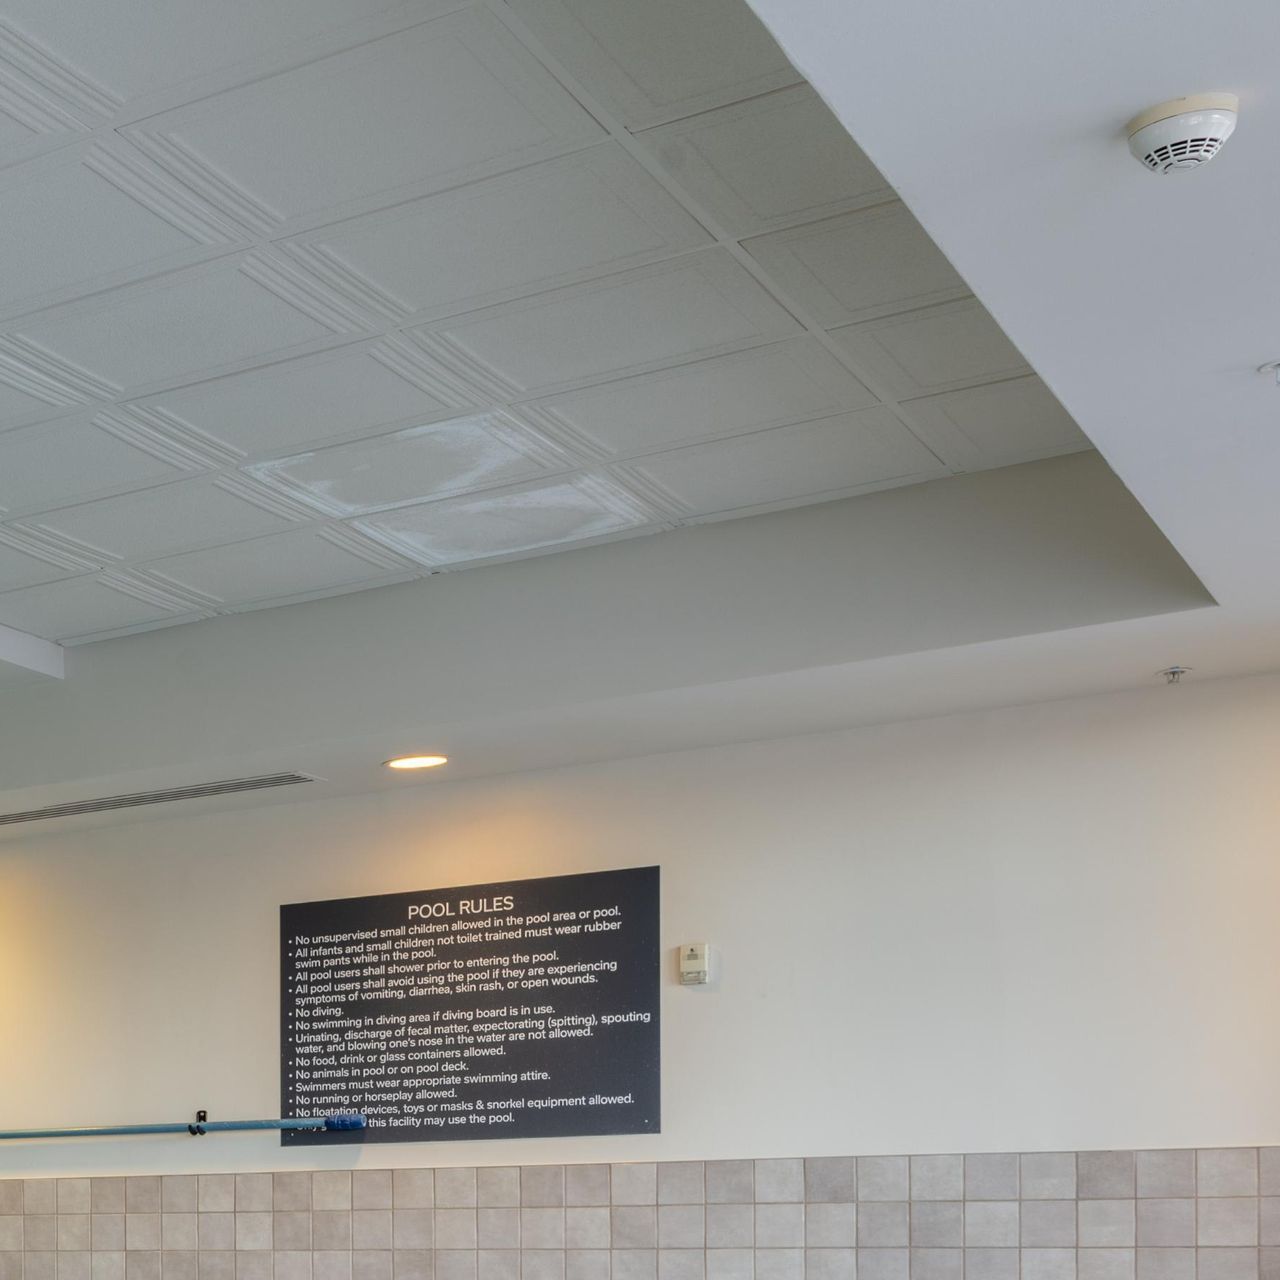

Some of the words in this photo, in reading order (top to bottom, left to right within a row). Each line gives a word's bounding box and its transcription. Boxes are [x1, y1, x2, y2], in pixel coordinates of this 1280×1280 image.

[408, 902, 455, 919] POOL
[459, 896, 513, 914] RULES
[295, 935, 309, 945] No
[312, 928, 377, 943] unsupervised
[380, 925, 405, 937] small
[408, 923, 448, 934] children
[451, 917, 490, 930] allowed
[494, 917, 503, 926] in
[506, 915, 523, 925] the
[526, 912, 549, 925] pool
[552, 911, 575, 921] area
[578, 910, 590, 918] or
[593, 905, 621, 919] pool.
[295, 948, 307, 957] All
[310, 946, 342, 956] infants
[345, 943, 363, 953] and
[366, 940, 391, 951] small
[394, 937, 434, 948] children
[437, 935, 454, 945] not
[456, 932, 482, 943] toilet
[484, 928, 521, 940] trained
[524, 926, 552, 937] must
[554, 925, 581, 934] wear
[584, 920, 622, 932] rubber
[295, 984, 307, 993] All
[310, 982, 331, 994] pool
[334, 982, 360, 991] users
[363, 978, 385, 988] shall
[387, 976, 414, 986] avoid
[417, 974, 444, 984] using
[447, 972, 463, 982] the
[466, 969, 489, 981] pool
[492, 968, 499, 978] if
[501, 968, 525, 977] they
[528, 967, 544, 975] are
[547, 960, 617, 974] experiencing
[295, 994, 345, 1006] symptoms
[348, 991, 358, 1000] of
[360, 988, 405, 999] vomiting,
[408, 983, 452, 996] diarrhea,
[455, 982, 476, 992] skin
[479, 980, 504, 990] rash,
[521, 978, 548, 989] open
[551, 973, 598, 985] wounds.
[295, 1008, 310, 1017] No
[312, 1006, 343, 1016] diving.
[295, 1021, 310, 1030] No
[312, 1017, 361, 1029] swimming
[364, 1016, 373, 1025] in
[376, 1014, 406, 1025] diving
[408, 1014, 430, 1022] area
[433, 1011, 439, 1020] if
[442, 1009, 473, 1020] diving
[476, 1006, 506, 1017] board
[509, 1006, 518, 1015] is
[521, 1005, 530, 1014] in
[533, 1005, 555, 1014] use.
[295, 1032, 341, 1043] Urinating,
[344, 1029, 392, 1039] discharge
[394, 1026, 405, 1036] of
[407, 1025, 431, 1035] fecal
[434, 1024, 469, 1033] matter,
[472, 1018, 544, 1032] expectorating
[547, 1014, 597, 1027] (spitting),
[601, 1011, 650, 1024] spouting
[295, 1044, 323, 1053] water,
[326, 1042, 344, 1051] and
[347, 1039, 386, 1050] blowing
[389, 1037, 415, 1048] one's
[418, 1037, 442, 1045] nose
[445, 1035, 454, 1044] in
[457, 1034, 473, 1043] the
[476, 1032, 505, 1042] water
[508, 1032, 525, 1040] are
[528, 1028, 546, 1039] not
[548, 1025, 593, 1038] allowed.
[295, 1082, 346, 1092] Swimmers
[348, 1079, 373, 1088] must
[403, 1075, 461, 1087] appropriate
[463, 1071, 517, 1083] swimming
[520, 1070, 550, 1080] attire.
[296, 1108, 310, 1117] No
[312, 1106, 357, 1116] floatation
[360, 1104, 400, 1114] devices,
[403, 1104, 424, 1113] toys
[440, 1101, 473, 1110] masks
[475, 1100, 484, 1109] &
[486, 1098, 524, 1109] snorkel
[527, 1096, 585, 1108] equipment
[588, 1093, 634, 1105] allowed.
[368, 1117, 386, 1127] this
[388, 1116, 421, 1127] facility
[424, 1117, 445, 1126] may
[448, 1116, 466, 1124] use
[468, 1113, 486, 1123] the
[488, 1112, 514, 1124] pool.
